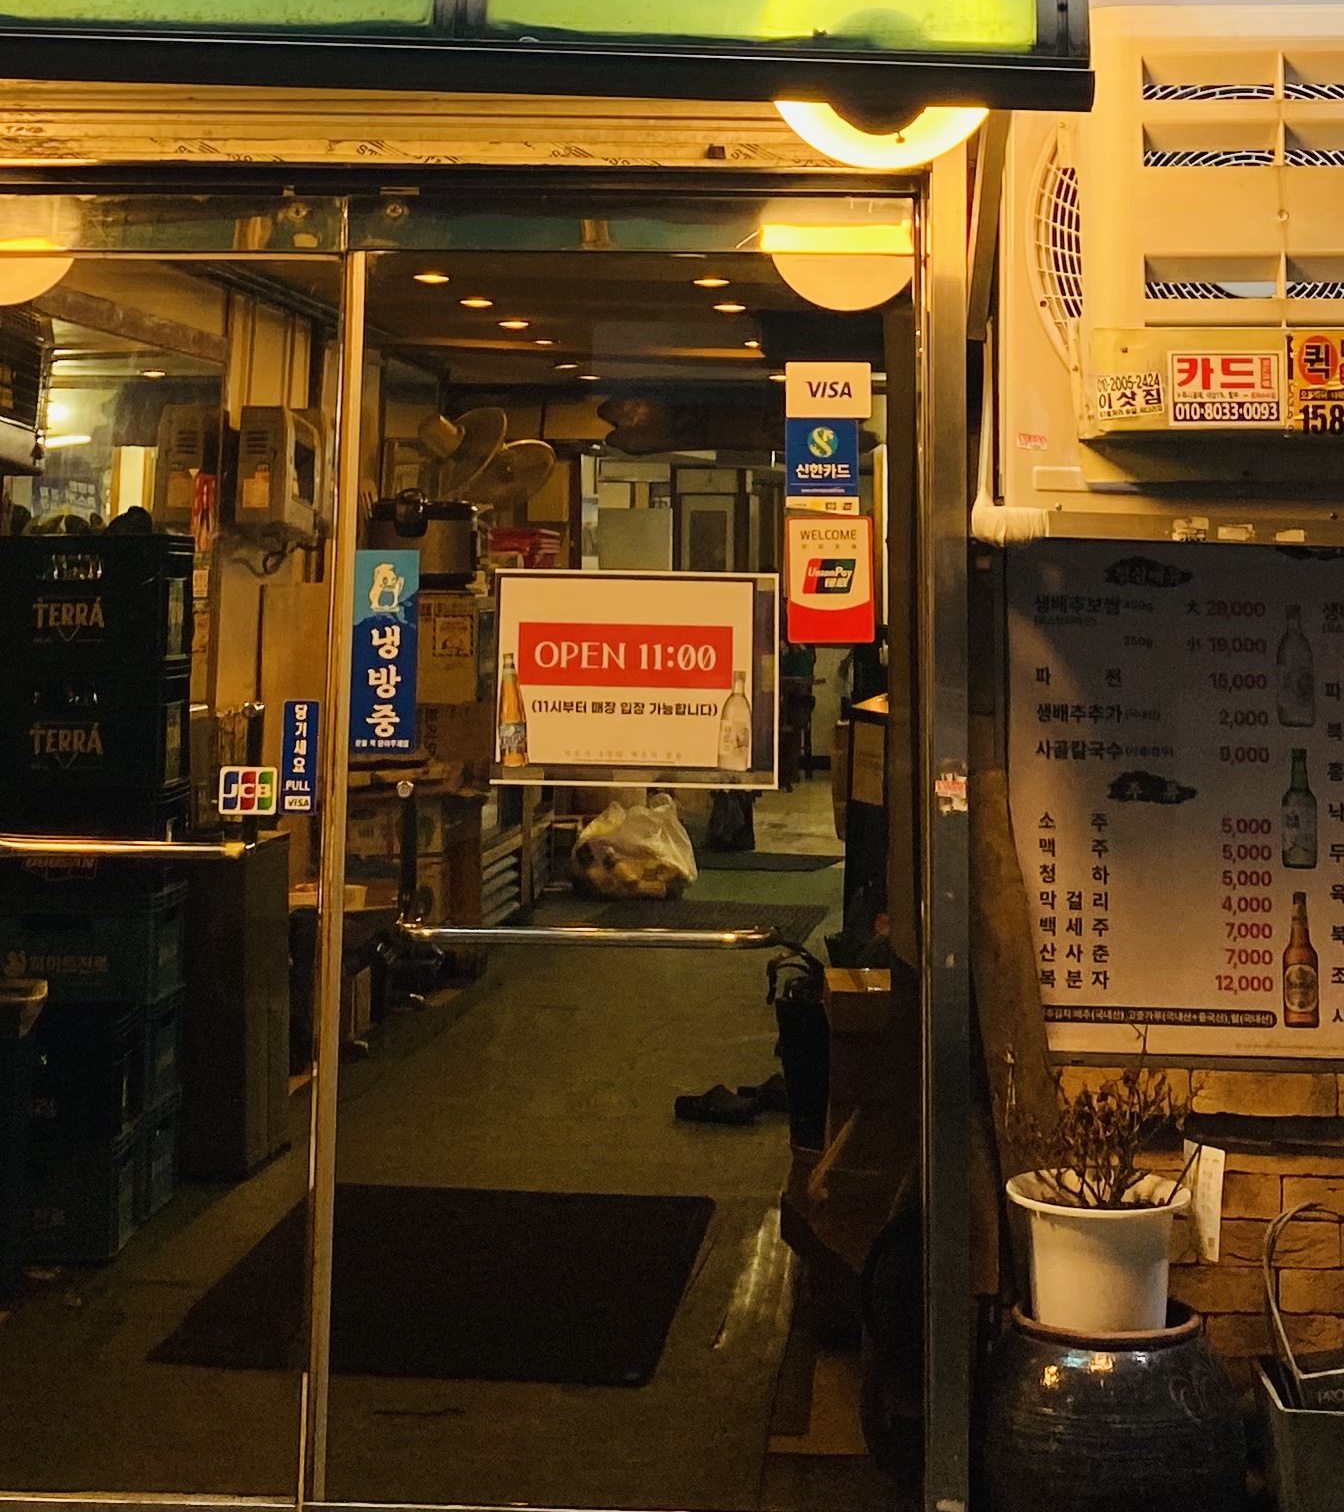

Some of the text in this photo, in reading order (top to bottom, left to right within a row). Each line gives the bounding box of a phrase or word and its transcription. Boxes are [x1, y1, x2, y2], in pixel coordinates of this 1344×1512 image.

[1303, 343, 1331, 380] 퀵
[1176, 357, 1256, 390] 카드
[805, 381, 853, 398] VISA
[1098, 387, 1163, 410] 이삿짐
[795, 463, 852, 479] 신한카드
[800, 529, 857, 541] WELCOME
[807, 566, 854, 580] UnionPay
[32, 595, 106, 630] TERRA
[533, 641, 718, 672] OPEN 11:00
[365, 624, 402, 738] 냉방중
[531, 700, 719, 717] (11시부터 매장 입장 가능합니다)
[1036, 702, 1124, 724] 생배추추가
[1218, 709, 1269, 727] 2,000
[29, 722, 104, 755] TERRA
[293, 704, 308, 773] 당기세요
[1035, 740, 1124, 761] 사골칼국수
[222, 782, 272, 799] JCB
[285, 780, 310, 792] PULL
[288, 797, 310, 807] VISA
[1221, 818, 1273, 836] 5,000
[1221, 844, 1273, 863] 5,000
[1222, 870, 1273, 890] 5,000
[1221, 896, 1273, 916] 4,000
[1225, 923, 1273, 942] 7,000
[1225, 949, 1273, 968] 7,000
[1215, 974, 1273, 995] 12,000
